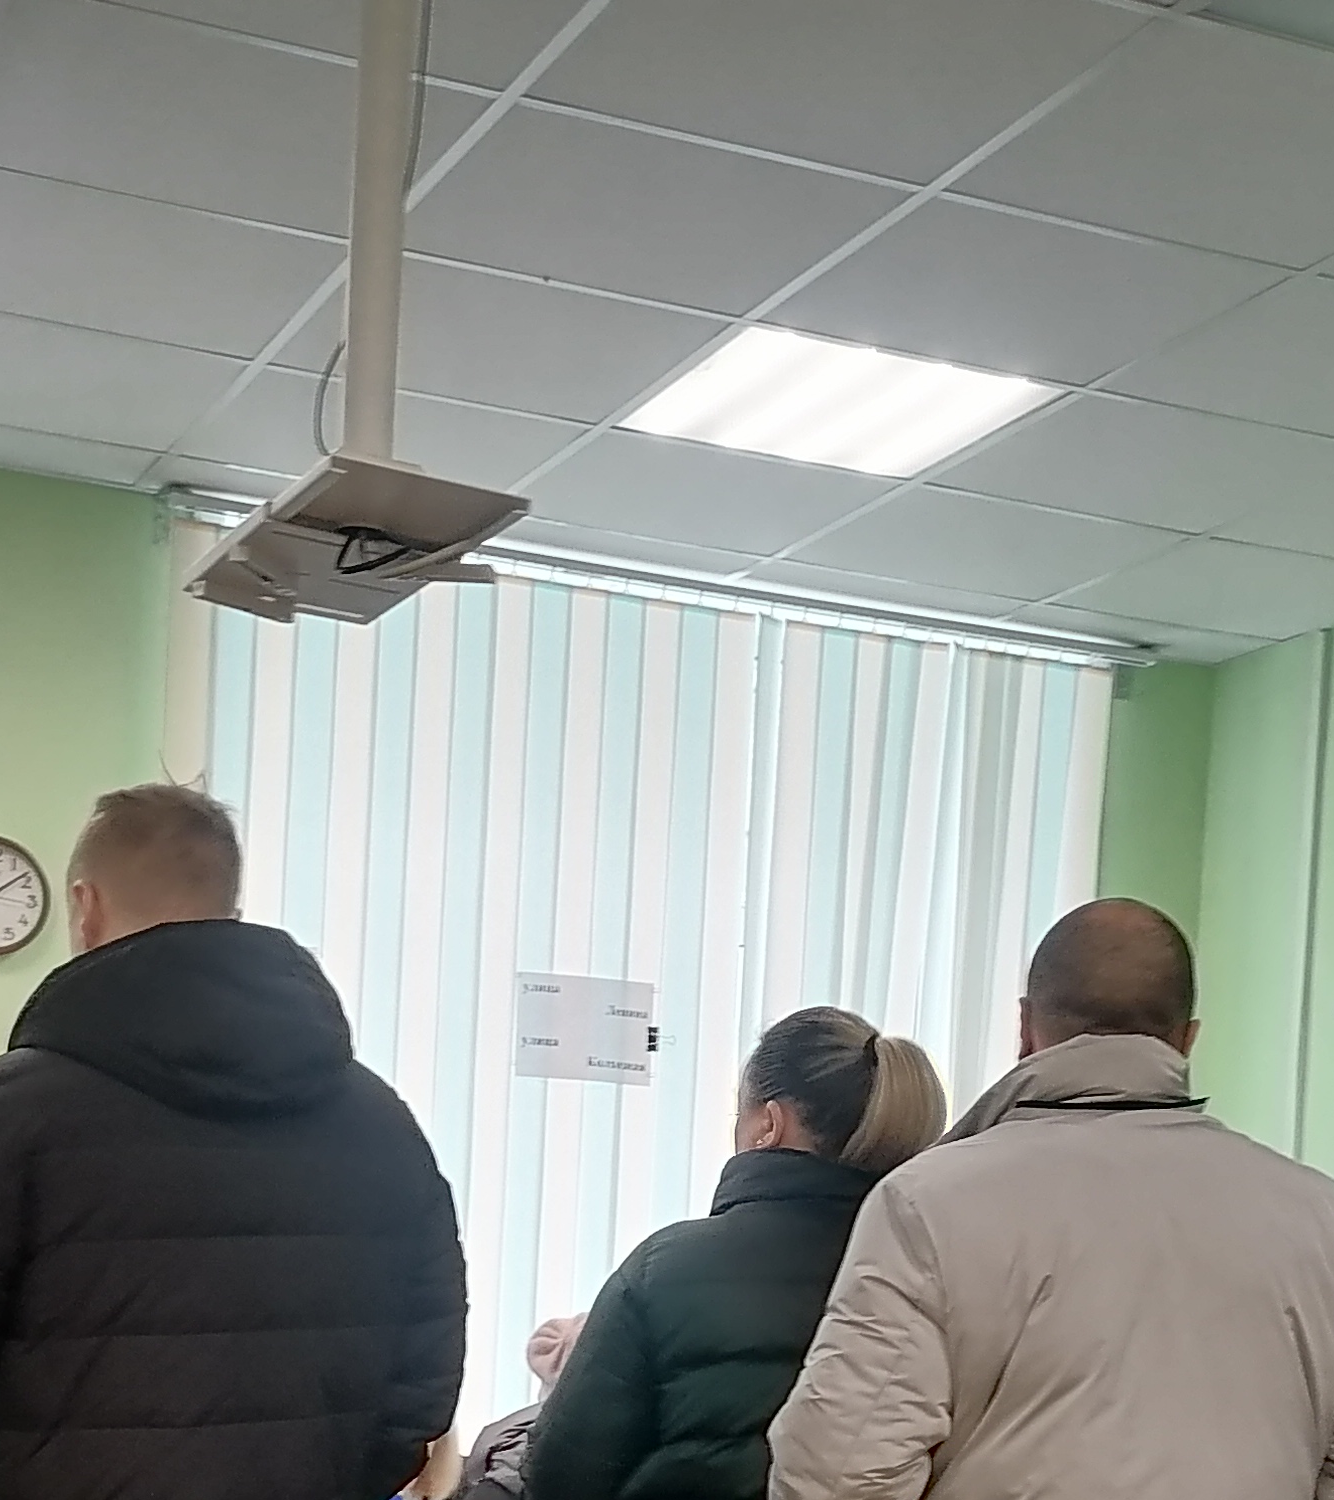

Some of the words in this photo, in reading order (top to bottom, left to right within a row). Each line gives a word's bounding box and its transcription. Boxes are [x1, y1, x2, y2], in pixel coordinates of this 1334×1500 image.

[10, 858, 17, 871] 1
[20, 876, 32, 889] 2
[27, 895, 38, 908] 3
[18, 914, 29, 926] 4
[3, 927, 15, 940] 5
